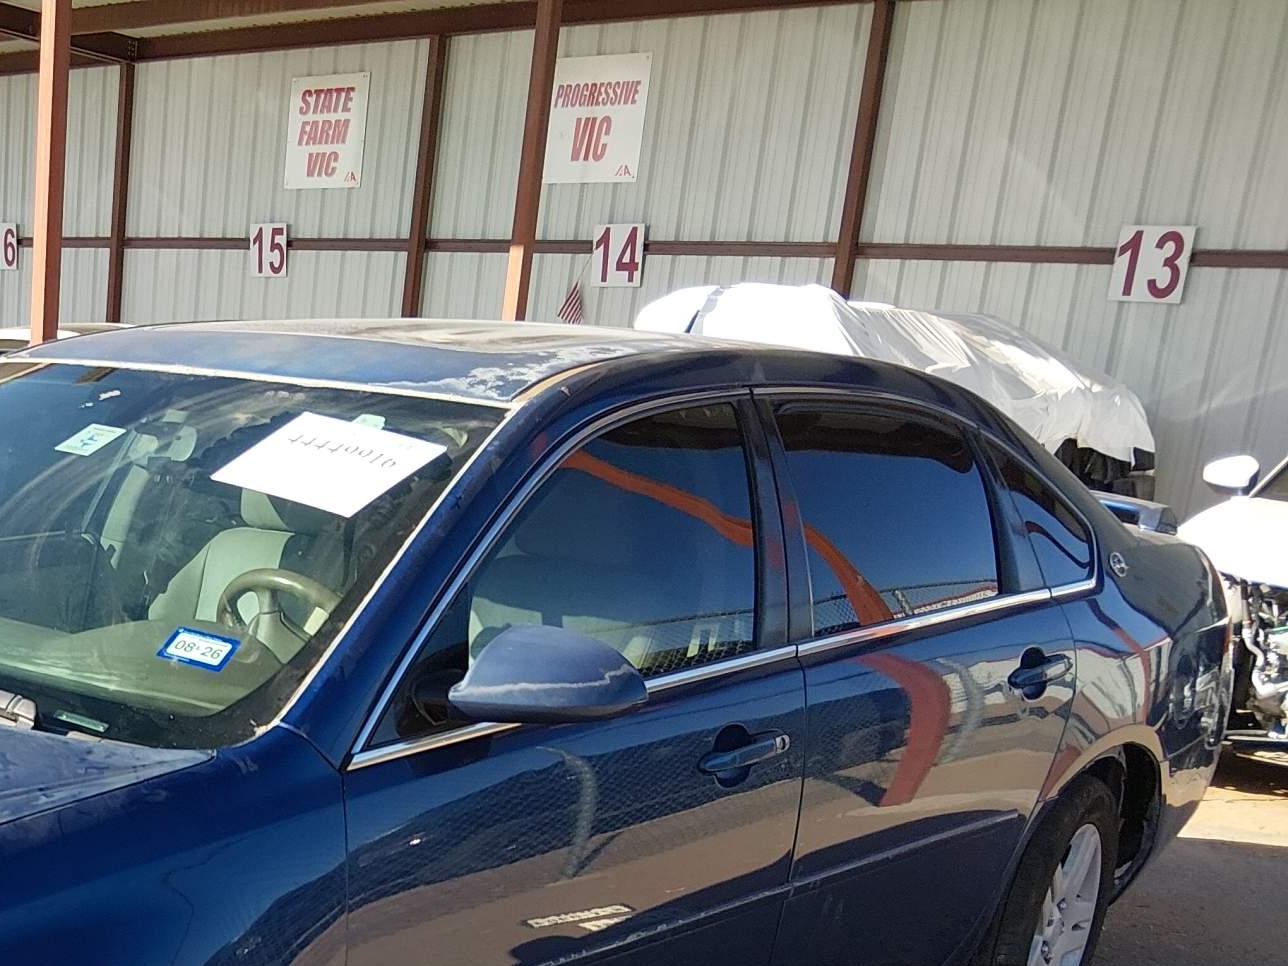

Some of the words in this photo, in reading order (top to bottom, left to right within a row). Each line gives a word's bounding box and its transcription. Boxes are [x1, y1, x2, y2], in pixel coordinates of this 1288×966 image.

[299, 86, 356, 116] STATE
[554, 80, 642, 109] PROGRESSIVE
[297, 119, 352, 146] FARM
[570, 115, 612, 162] VIC
[306, 151, 340, 178] VIC
[253, 226, 285, 274] 15
[595, 226, 640, 283] 14
[1117, 229, 1185, 299] 13
